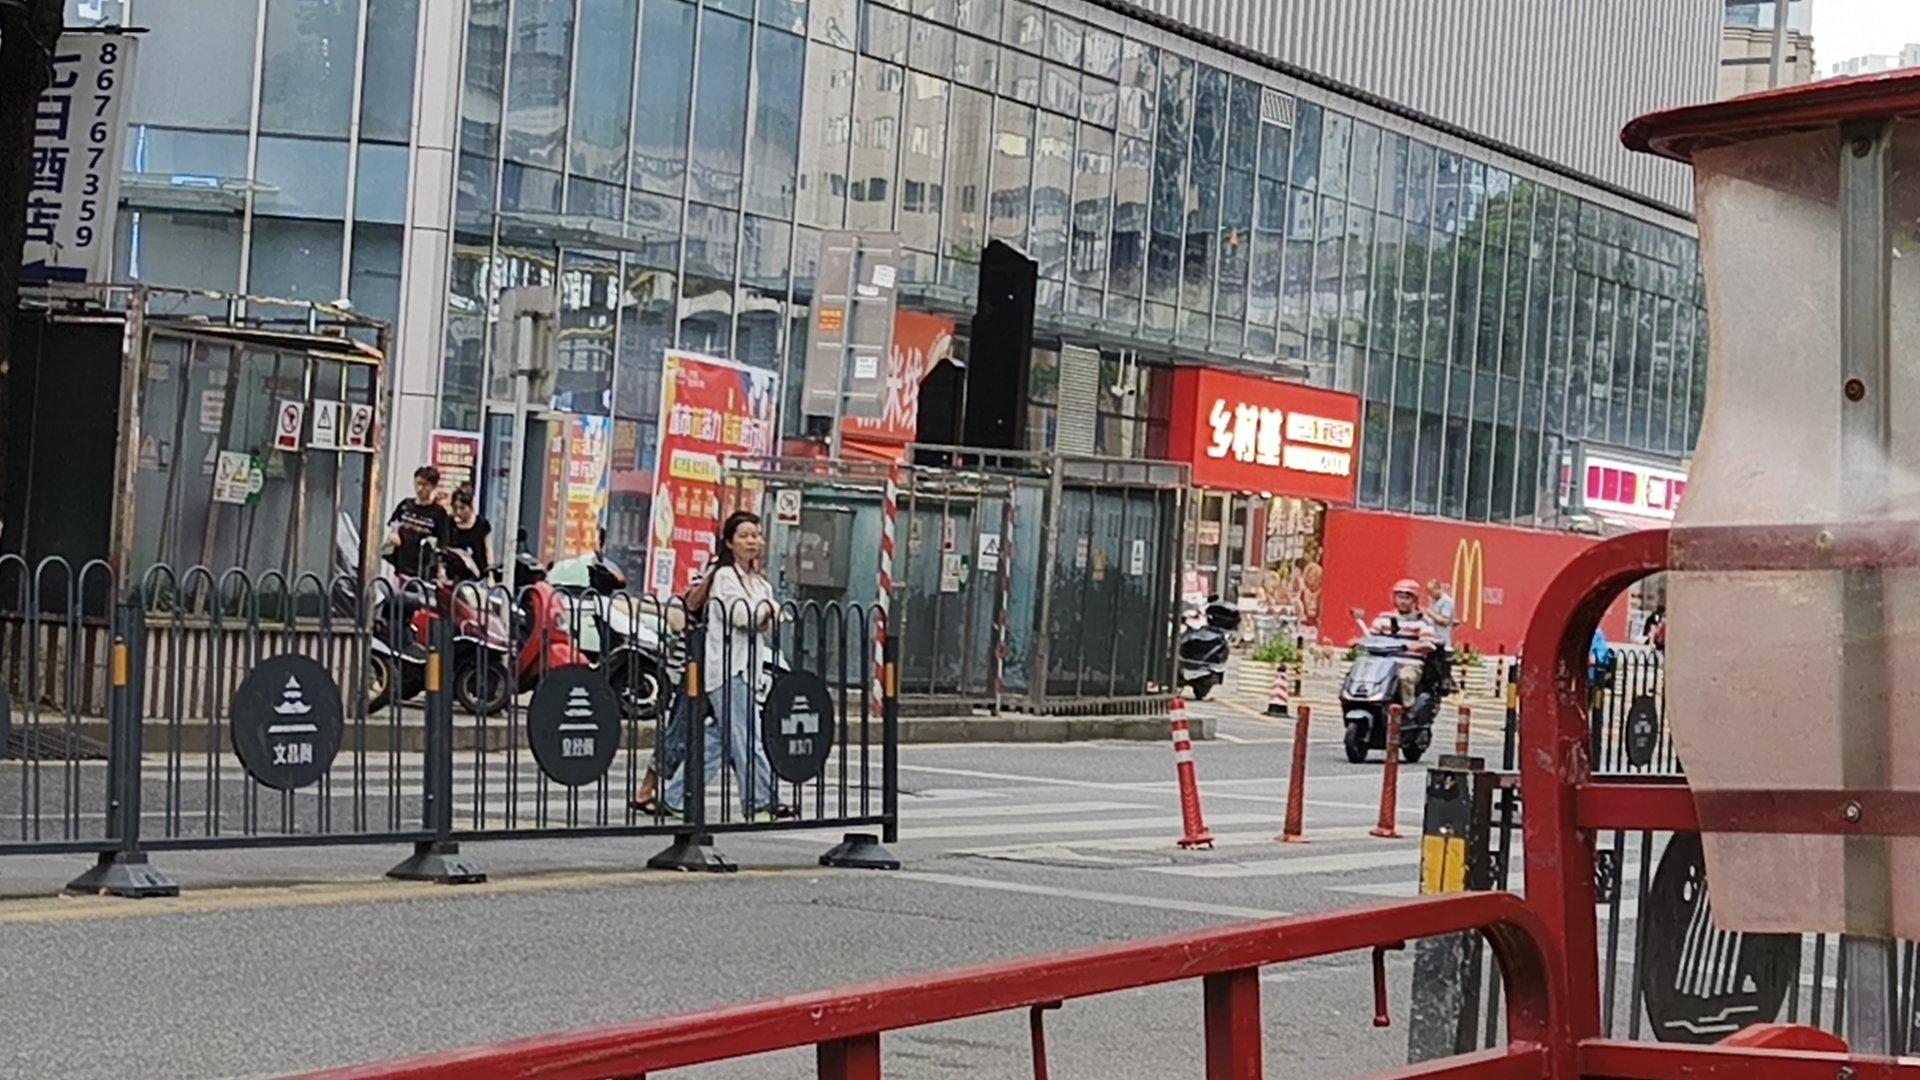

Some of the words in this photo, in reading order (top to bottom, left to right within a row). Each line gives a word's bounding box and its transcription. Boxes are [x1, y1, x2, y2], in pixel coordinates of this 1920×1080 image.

[76, 43, 118, 247] 86767359
[1206, 398, 1284, 467] 乡村基
[272, 742, 313, 765] 文昌阁
